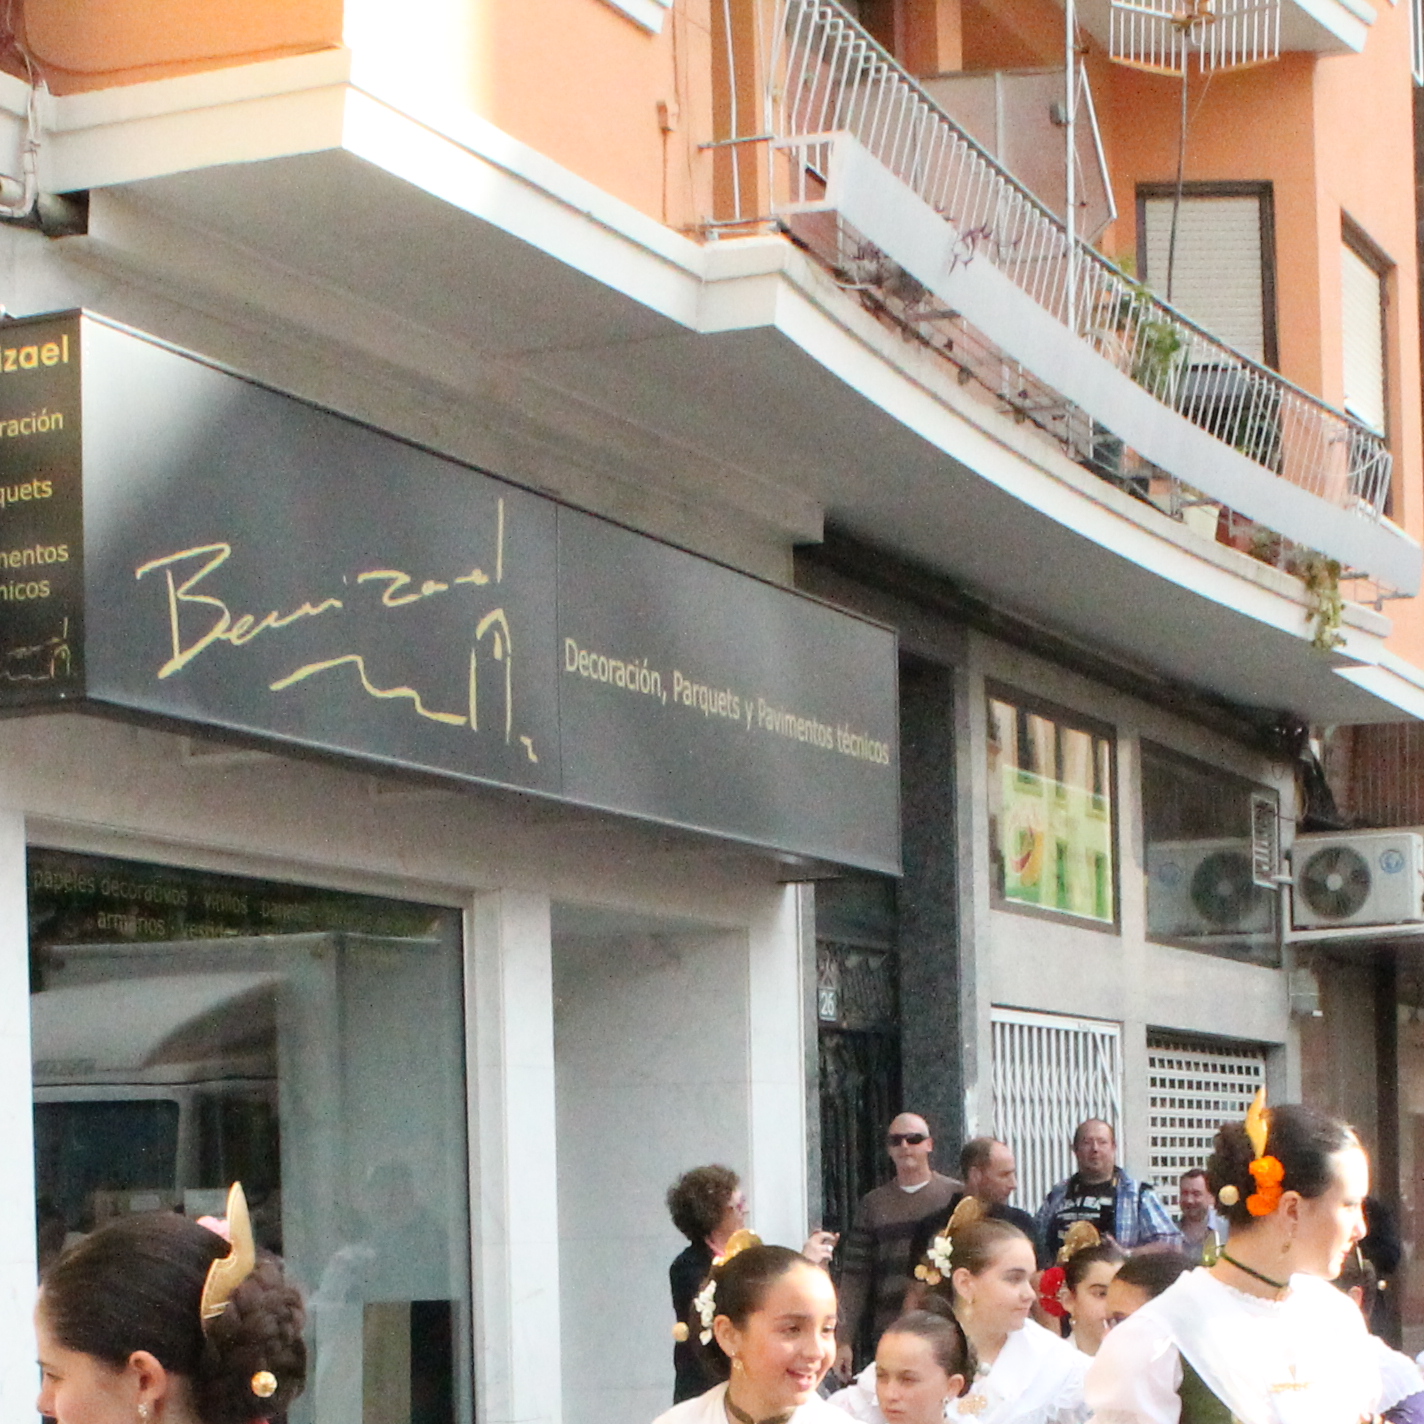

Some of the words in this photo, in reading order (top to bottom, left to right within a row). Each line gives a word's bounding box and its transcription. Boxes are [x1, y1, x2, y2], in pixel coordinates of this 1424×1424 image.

[563, 636, 667, 706] Decoración,
[672, 669, 741, 718] Parquets
[744, 702, 756, 731] y
[757, 697, 834, 751] Pavimentos
[837, 723, 891, 765] técnicos
[33, 868, 96, 894] papeles
[100, 877, 189, 907] decorativos
